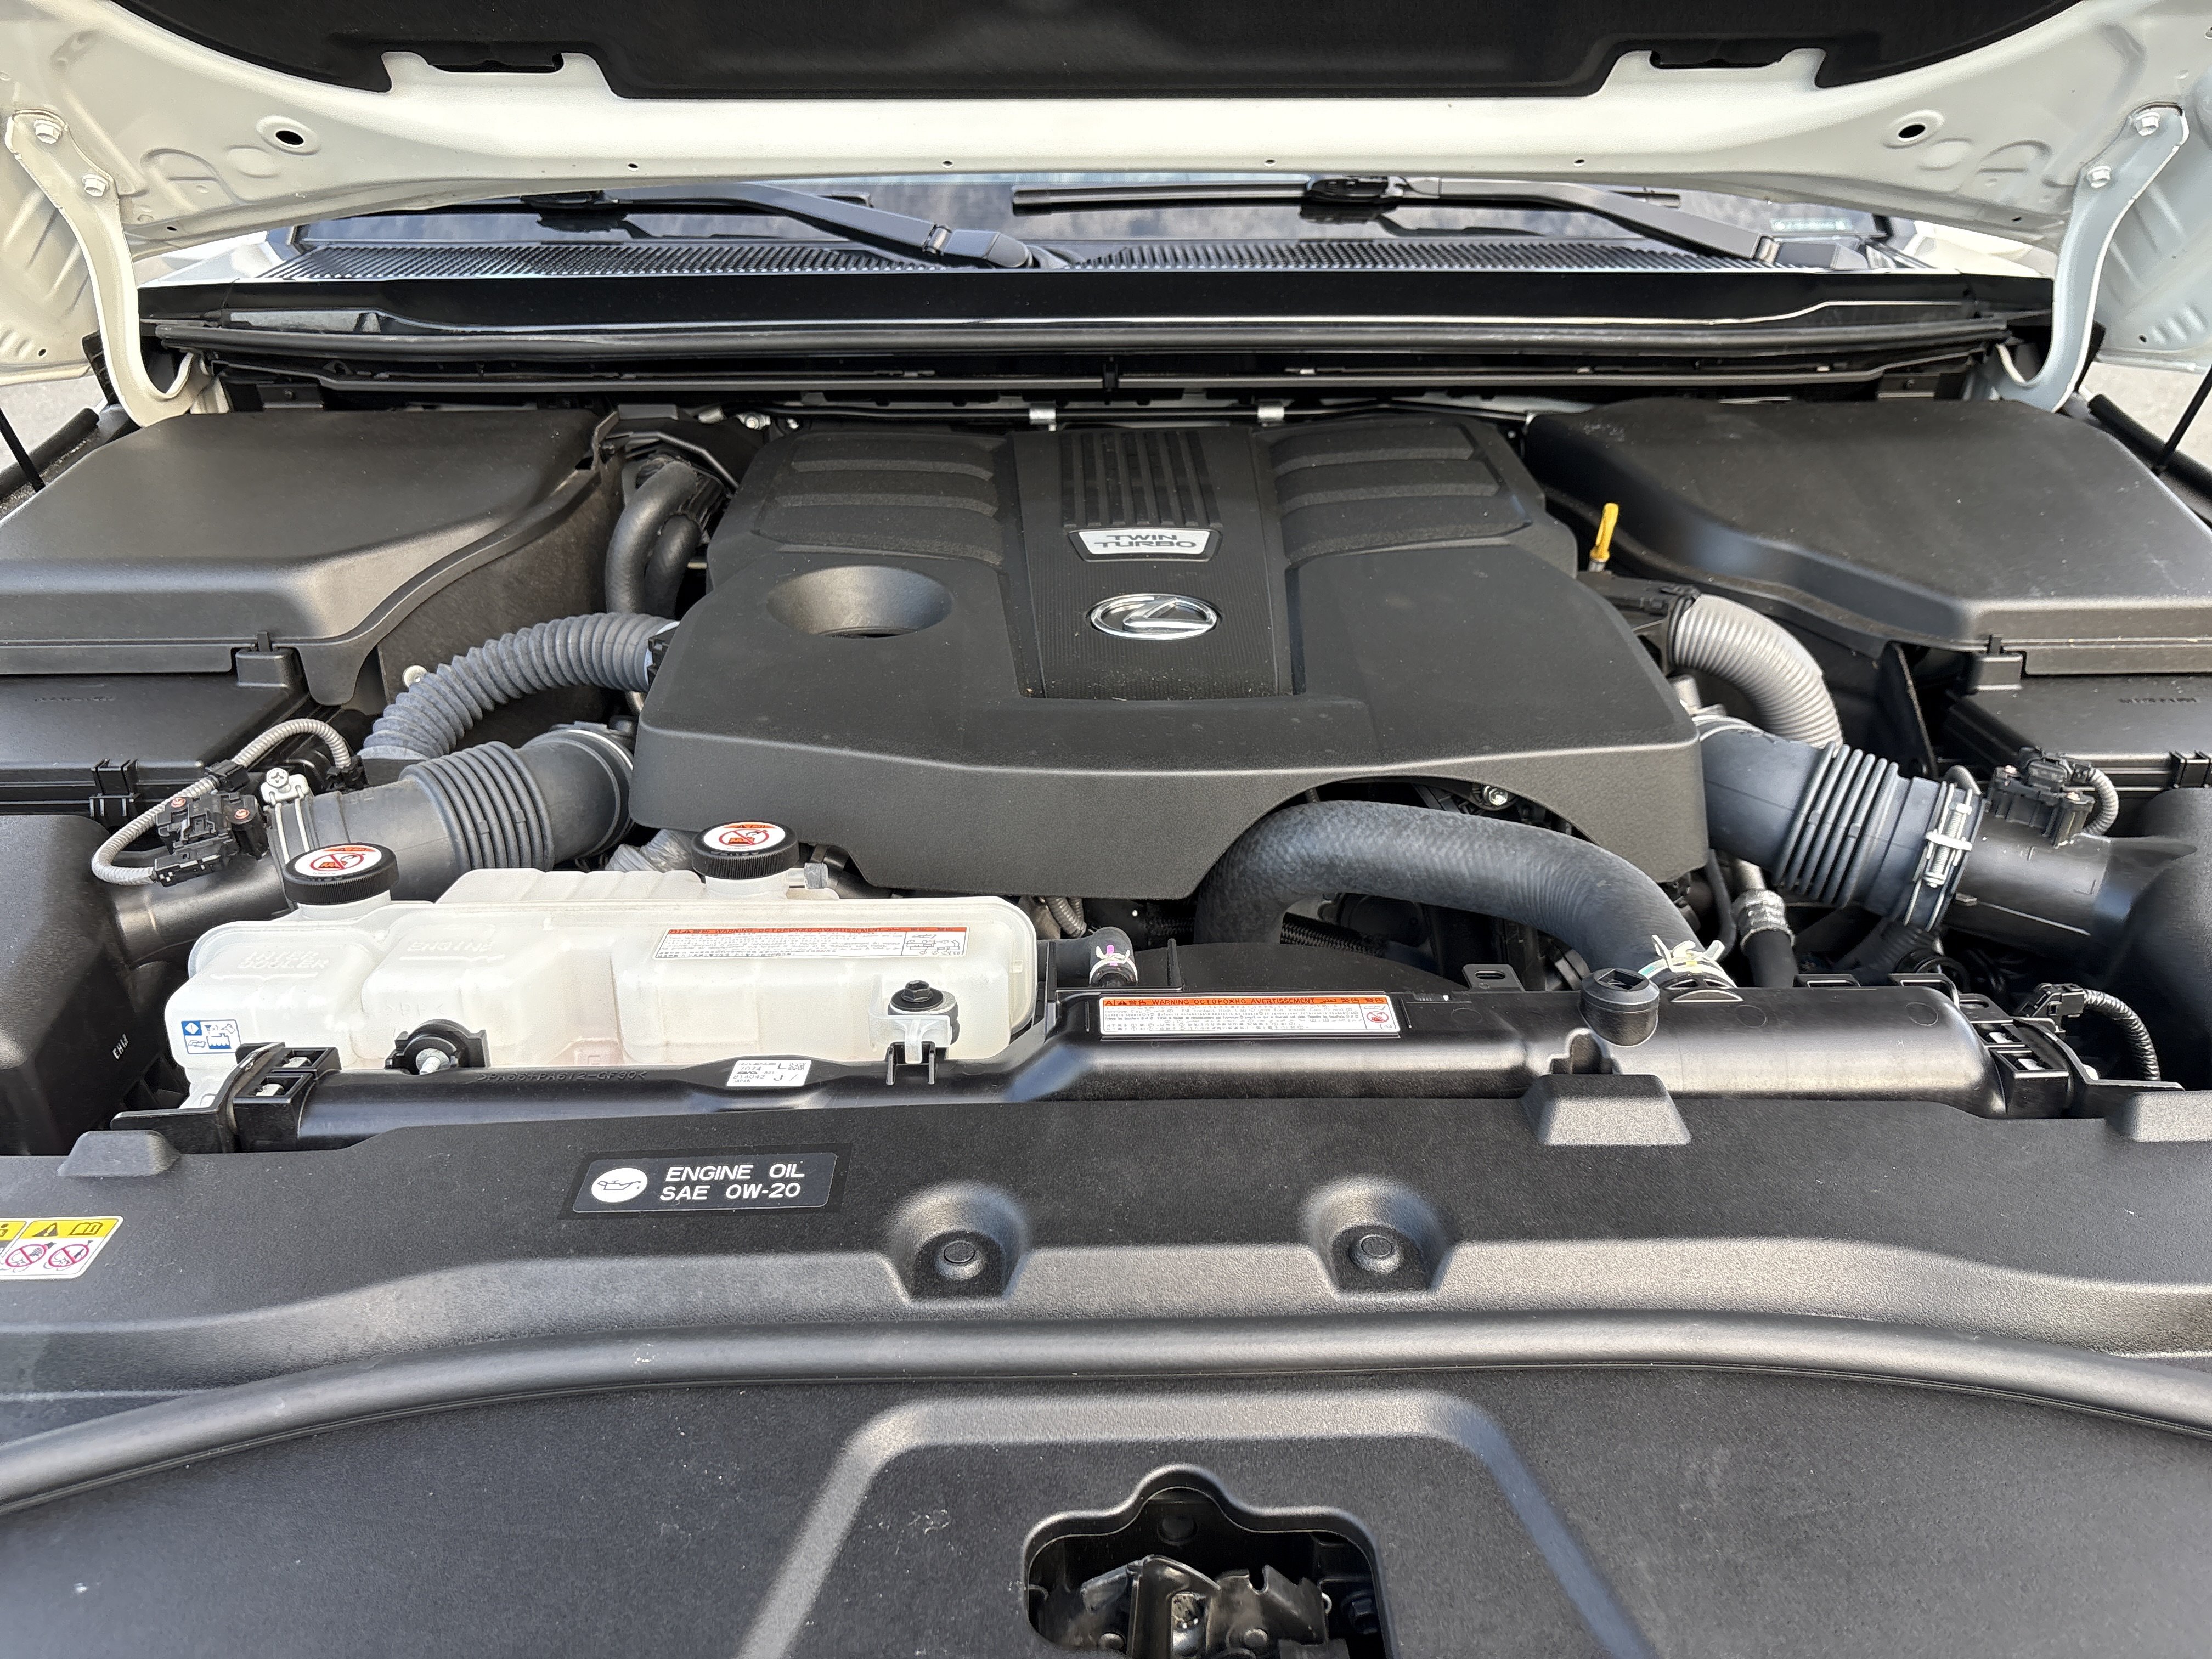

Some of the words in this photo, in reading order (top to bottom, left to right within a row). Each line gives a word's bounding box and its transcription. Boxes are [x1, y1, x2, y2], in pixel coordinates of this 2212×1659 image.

[665, 1164, 754, 1182] ENGINE
[769, 1163, 805, 1178] OIL
[659, 1185, 708, 1201] SAE
[726, 1182, 801, 1200] 0W-20
